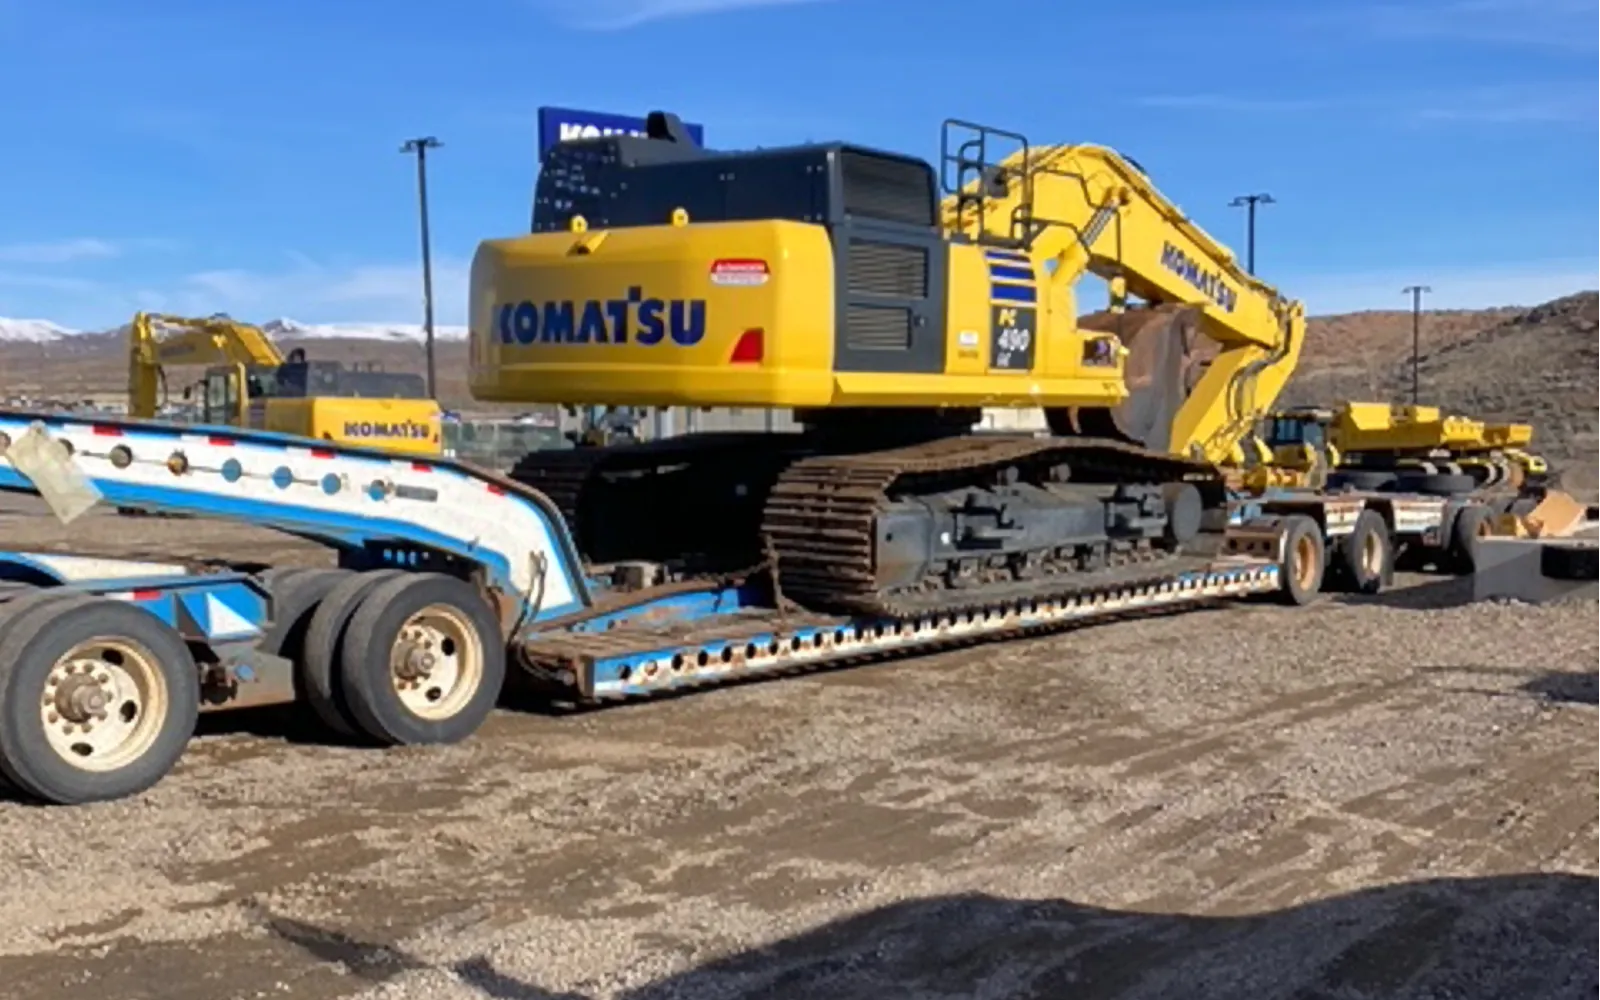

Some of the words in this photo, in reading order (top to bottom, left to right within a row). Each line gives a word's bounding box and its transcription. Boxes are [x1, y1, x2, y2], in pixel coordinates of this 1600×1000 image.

[1160, 240, 1237, 312] KOMATSU
[492, 285, 706, 345] KOMATSU
[998, 328, 1030, 351] 490
[343, 417, 430, 437] KOMATSU
